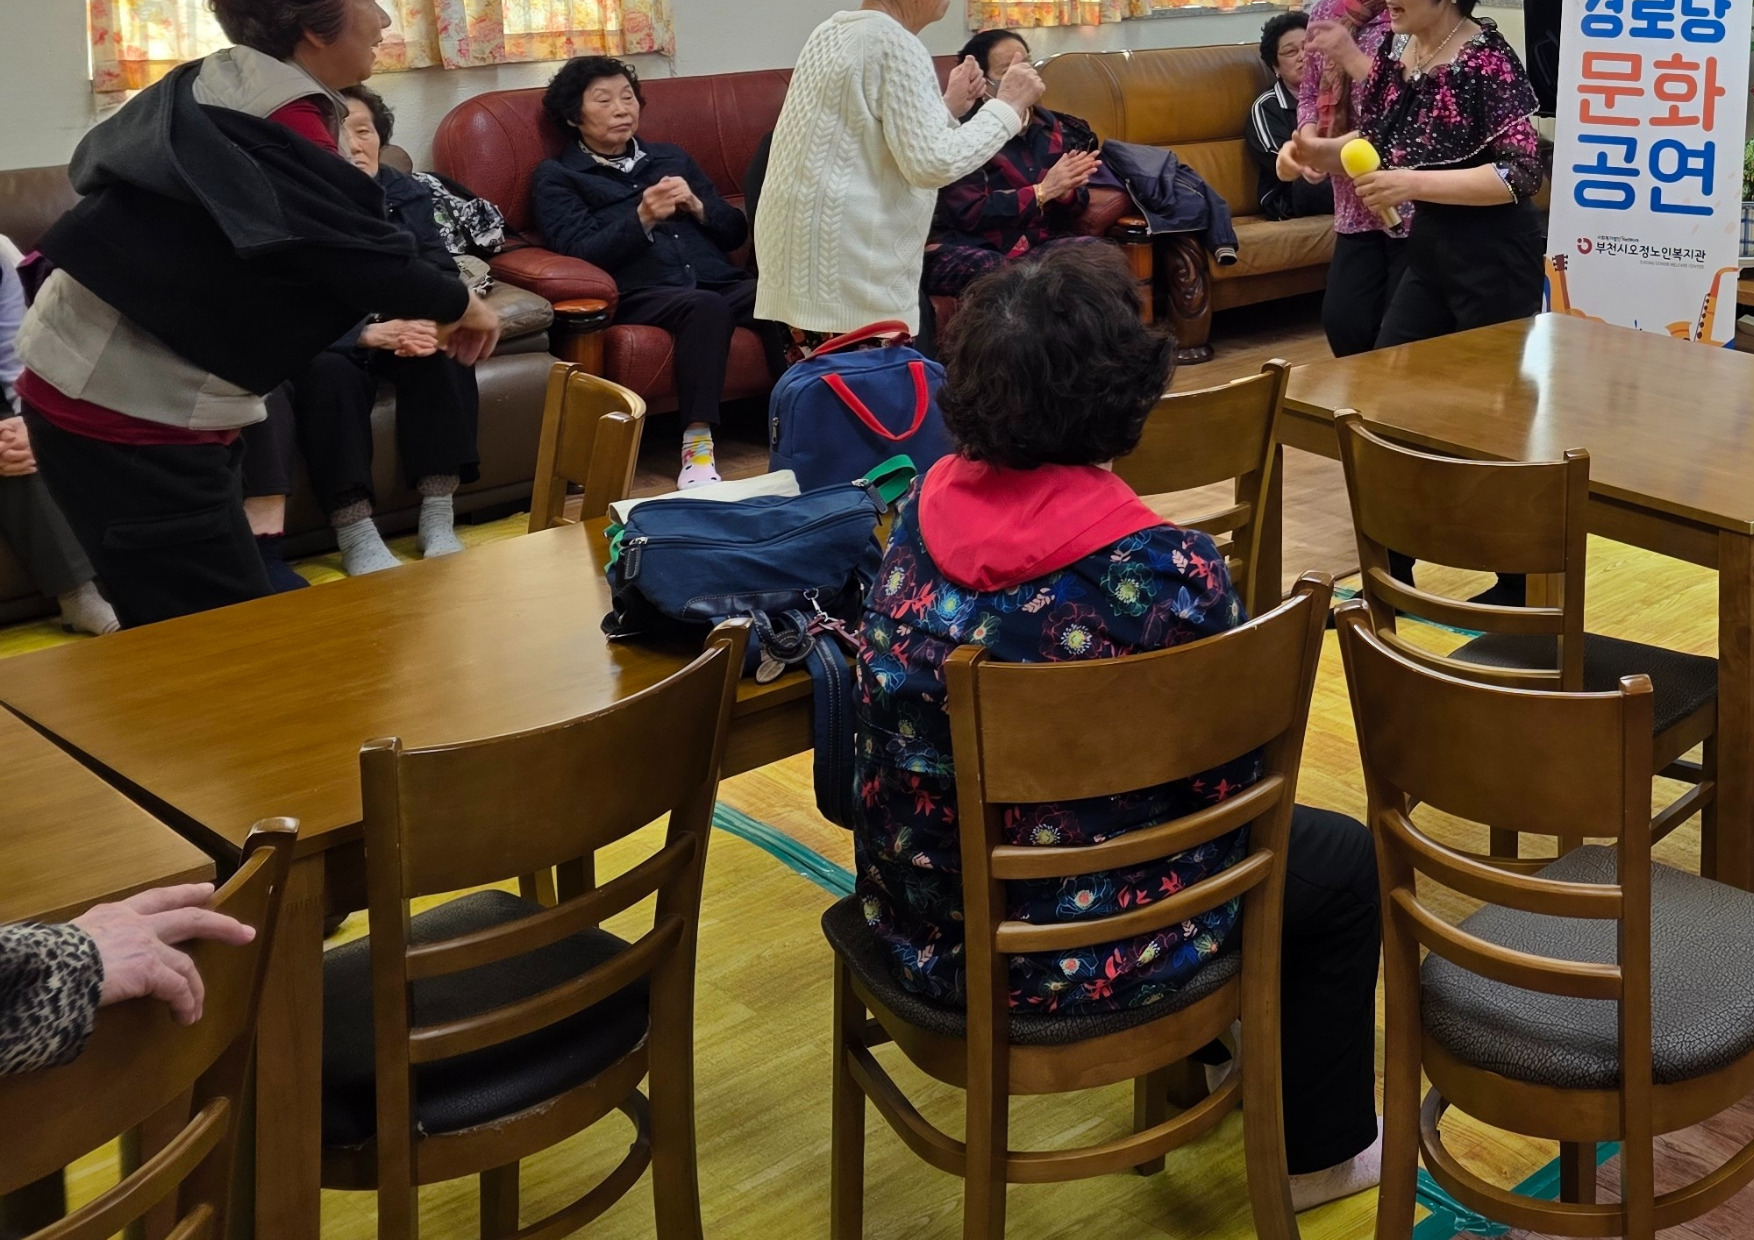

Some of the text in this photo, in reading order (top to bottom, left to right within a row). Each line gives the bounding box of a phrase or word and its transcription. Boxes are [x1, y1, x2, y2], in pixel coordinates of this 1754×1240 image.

[1577, 51, 1726, 132] 문화
[1572, 133, 1716, 216] 공연
[1595, 241, 1707, 263] 부천시오정노인복지관
